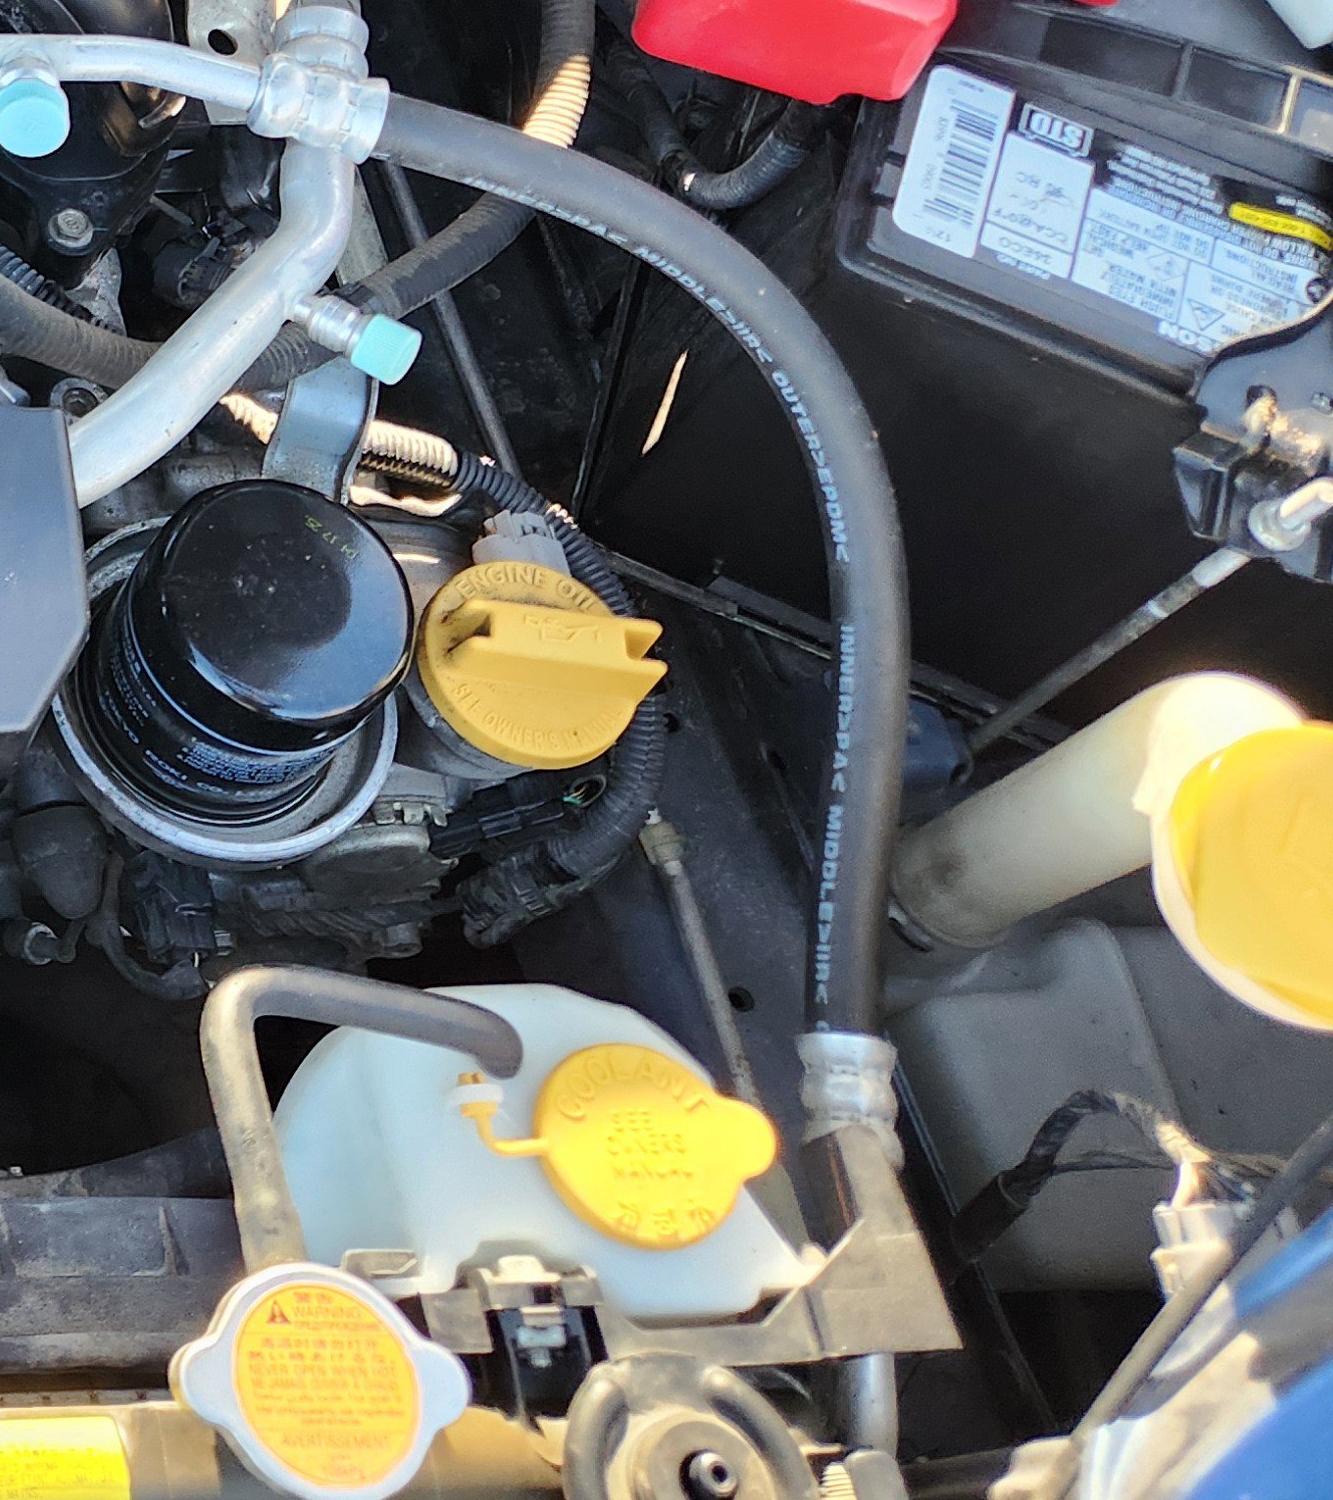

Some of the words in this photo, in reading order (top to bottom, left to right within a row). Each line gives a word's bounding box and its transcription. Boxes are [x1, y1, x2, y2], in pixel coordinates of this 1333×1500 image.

[1026, 110, 1086, 150] STD
[770, 370, 852, 564] OUTER>EPDM<
[455, 564, 547, 600] ENGINE
[556, 578, 598, 611] OIL
[452, 682, 483, 714] SEE
[564, 706, 623, 752] MANUAL
[558, 1047, 710, 1124] COOLANT
[611, 1110, 654, 1132] SEE
[606, 1132, 687, 1158] OWNERS
[292, 1305, 362, 1320] WARNING
[248, 1362, 289, 1376] NEVER
[293, 1363, 326, 1377] OPEN
[330, 1363, 368, 1377] WHEN
